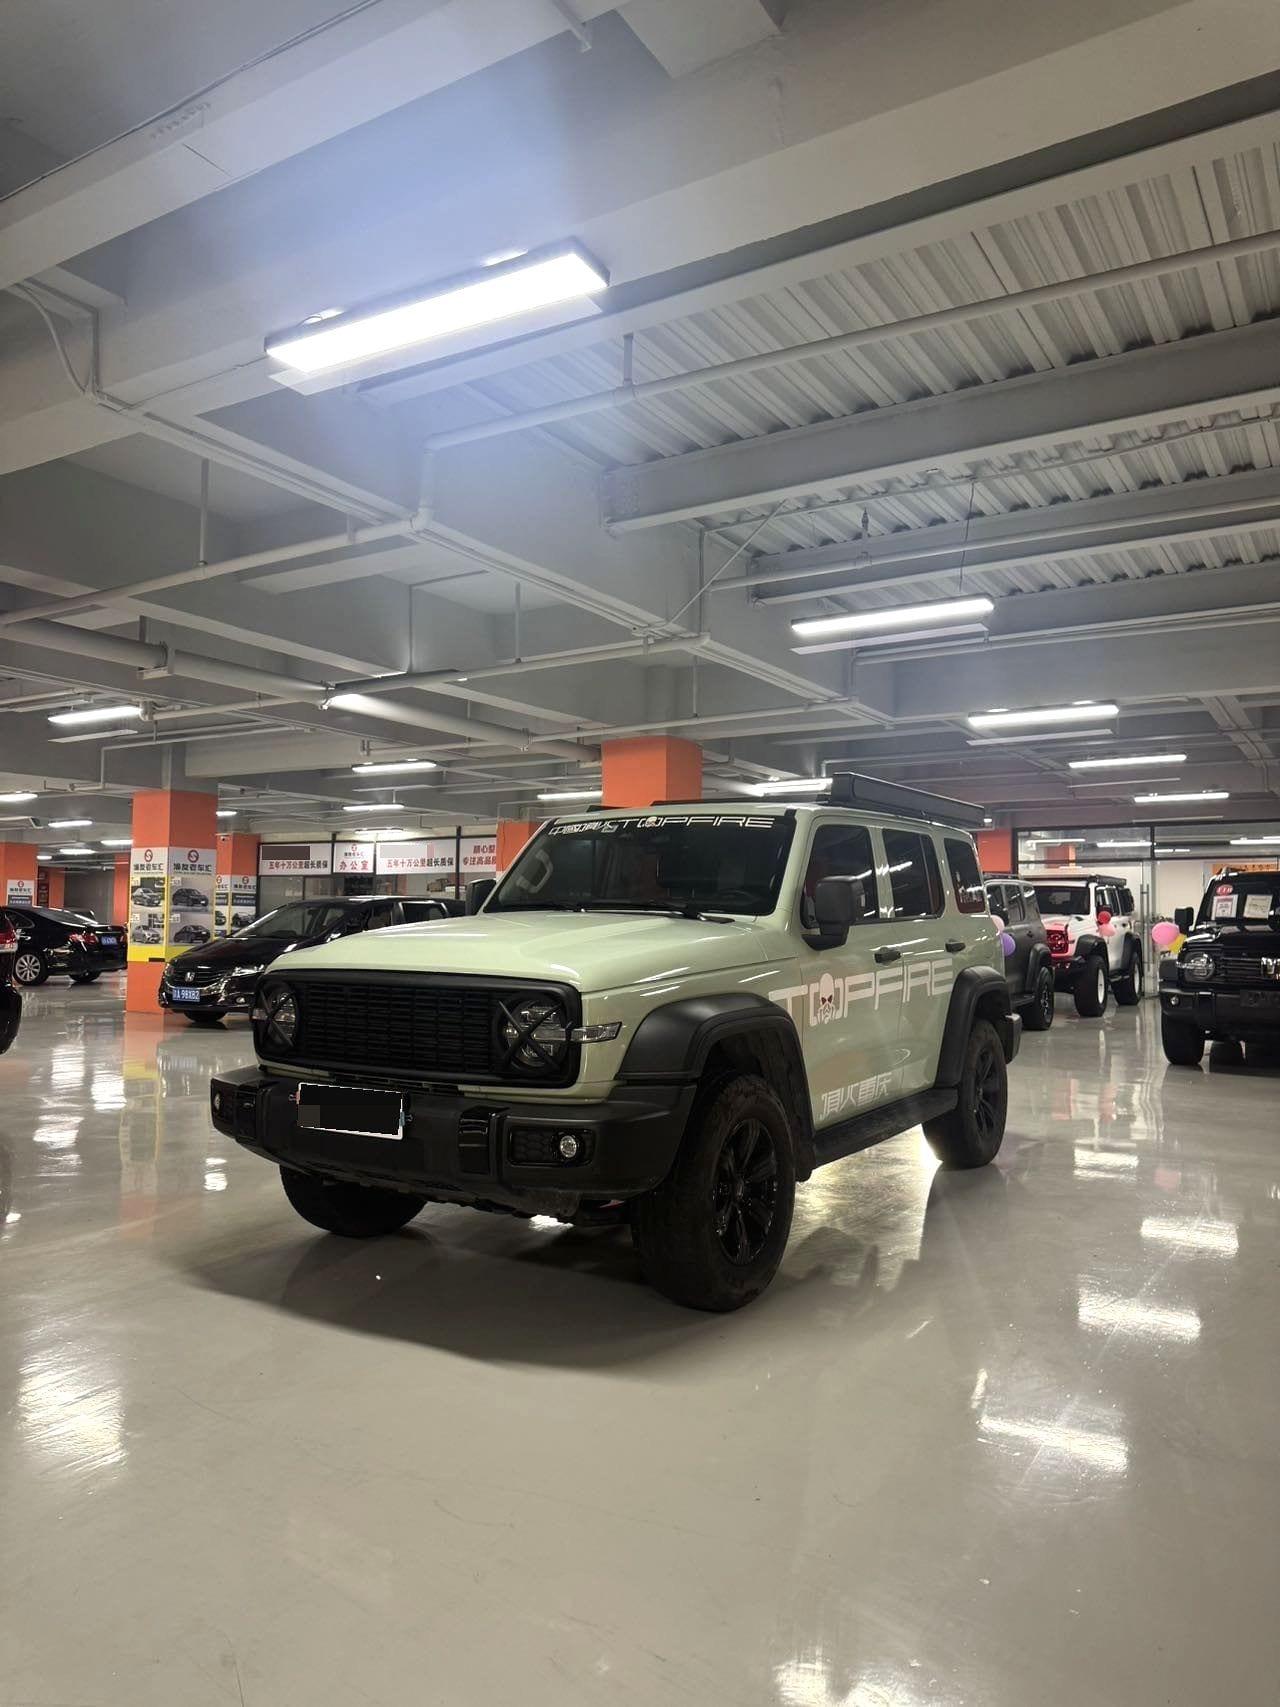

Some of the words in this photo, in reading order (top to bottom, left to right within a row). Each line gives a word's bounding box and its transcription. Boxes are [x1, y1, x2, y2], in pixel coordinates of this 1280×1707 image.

[621, 815, 776, 829] TOPFIRE
[268, 860, 329, 871] 五年十万公里超长质保
[339, 860, 369, 871] 办公室
[386, 857, 455, 869] 五年十万公里超长质保
[769, 958, 953, 1027] TOPFIRE
